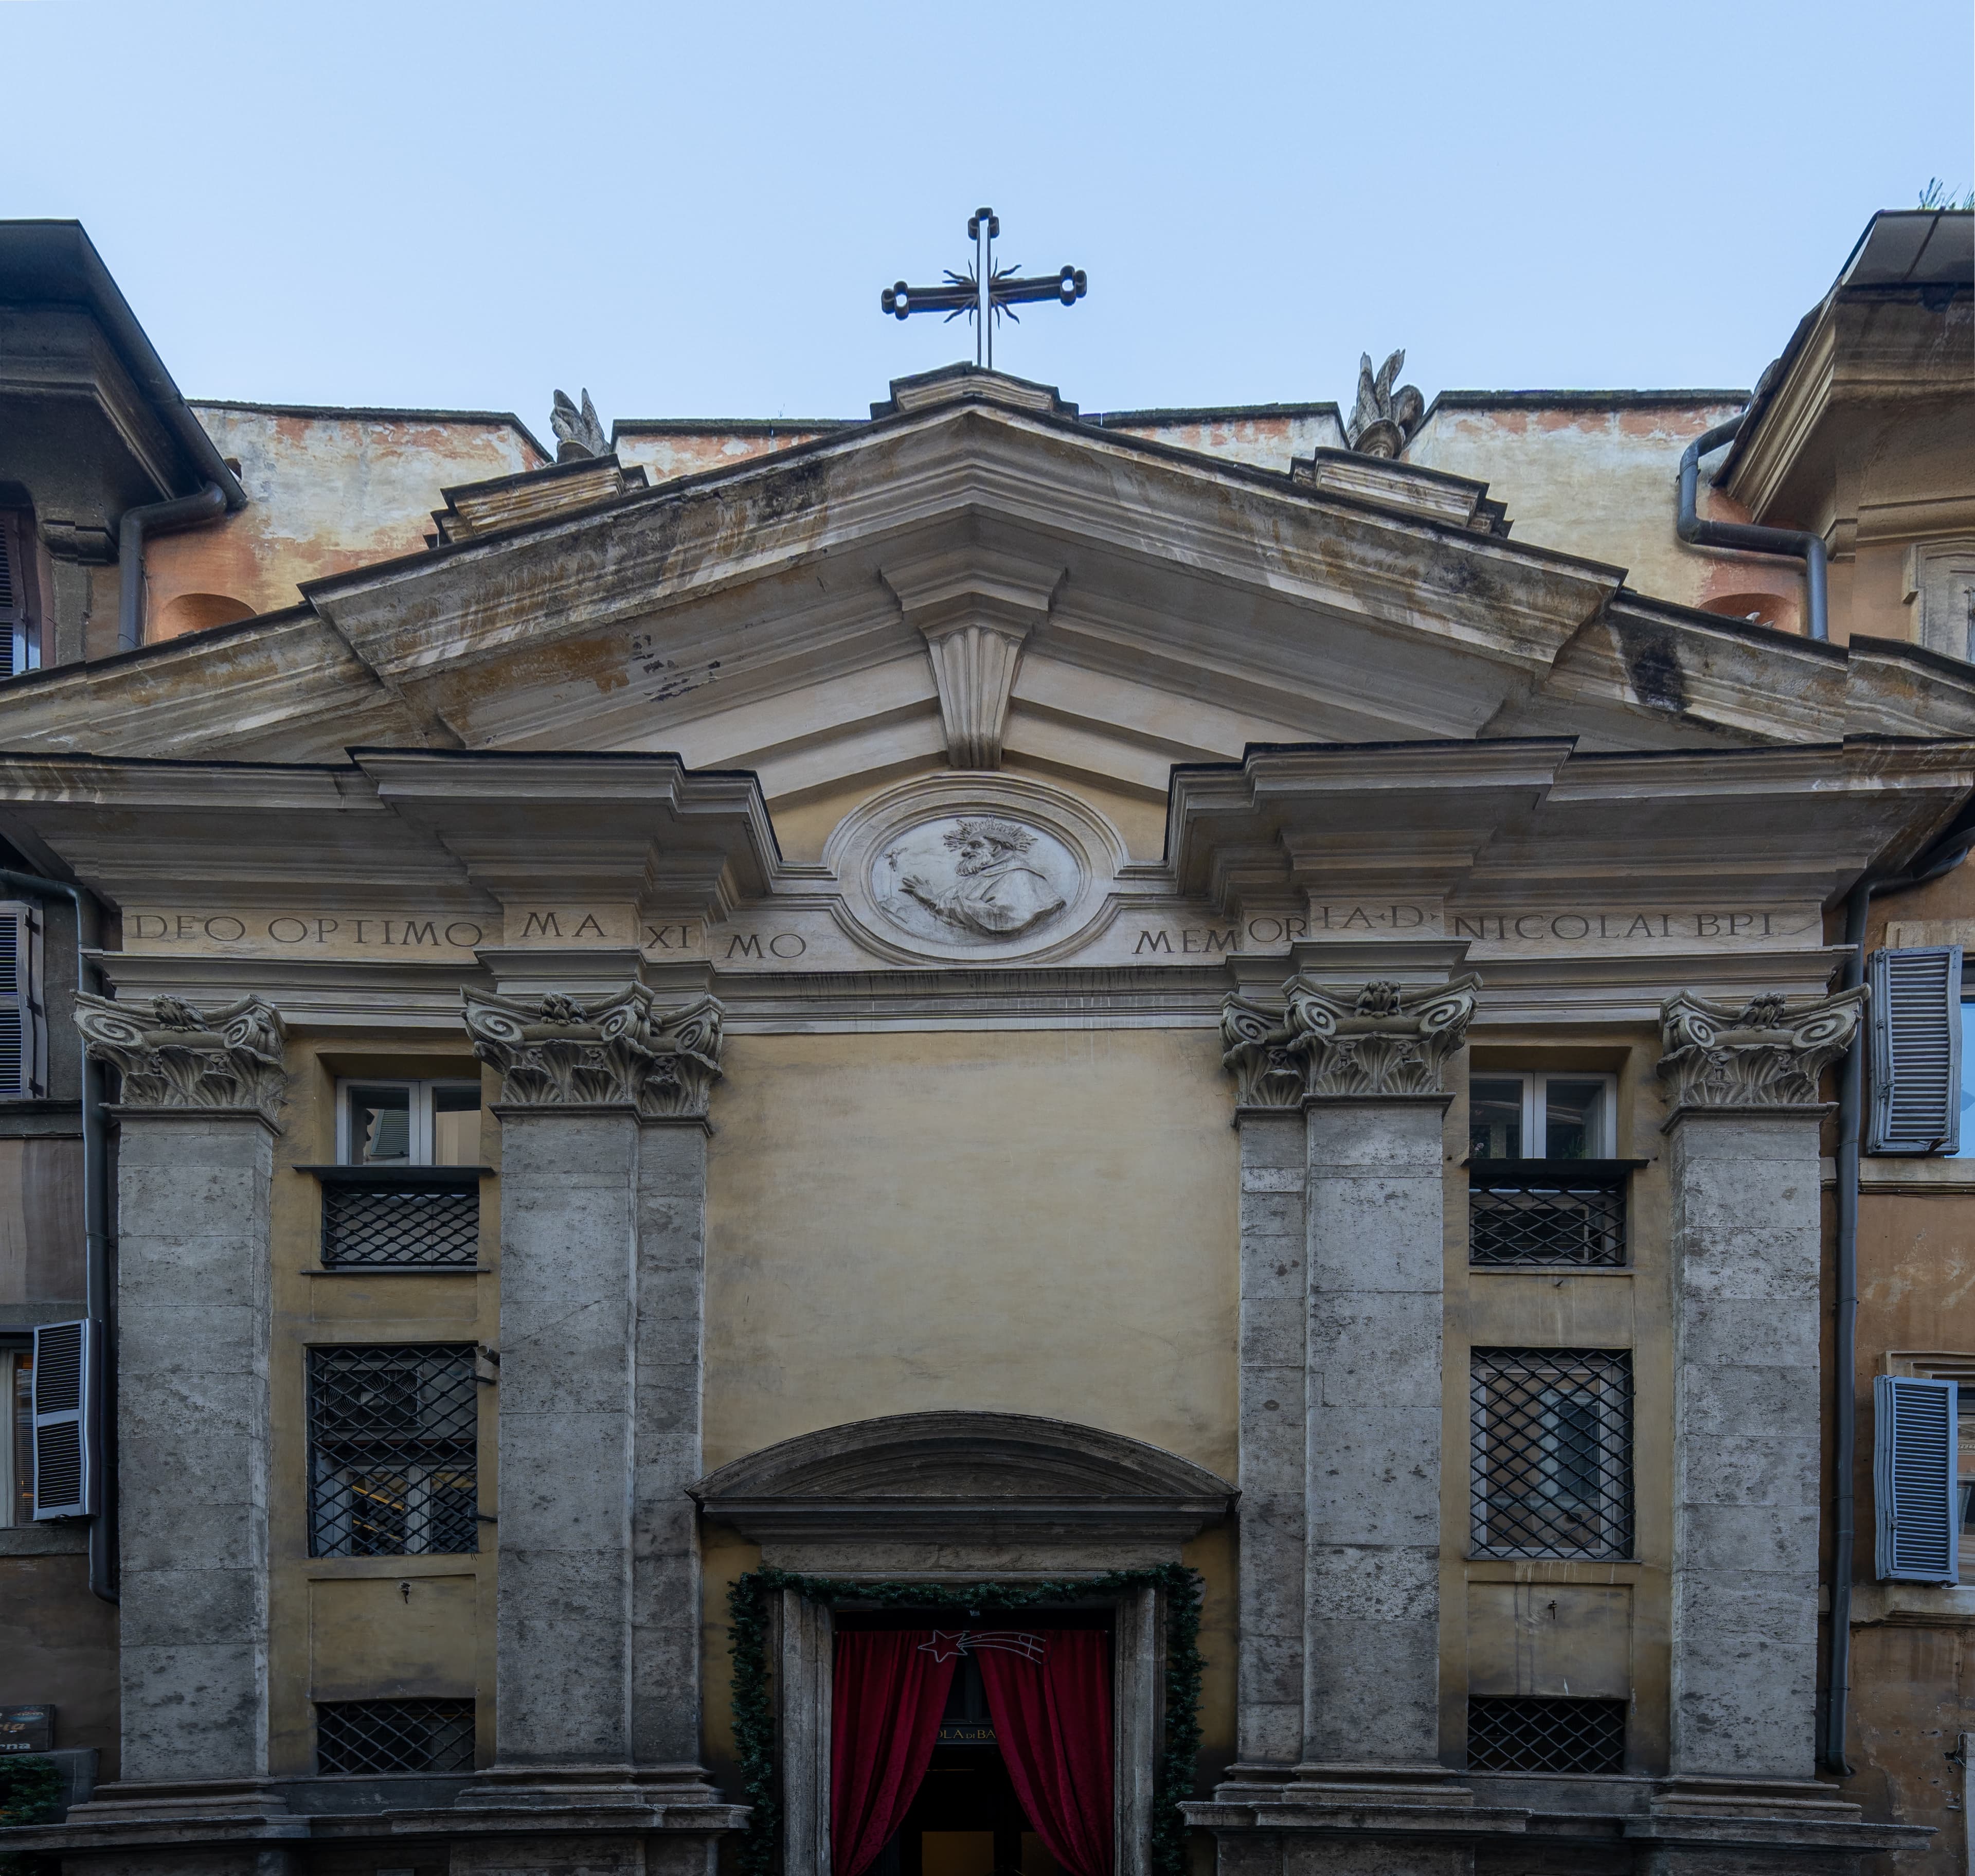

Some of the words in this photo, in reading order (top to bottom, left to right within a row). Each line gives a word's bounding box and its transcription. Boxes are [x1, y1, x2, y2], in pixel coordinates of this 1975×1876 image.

[131, 915, 246, 942] DEO
[268, 917, 483, 947] OPTIMO
[1453, 914, 1673, 940] NICOLAI
[1694, 912, 1774, 937] BPI
